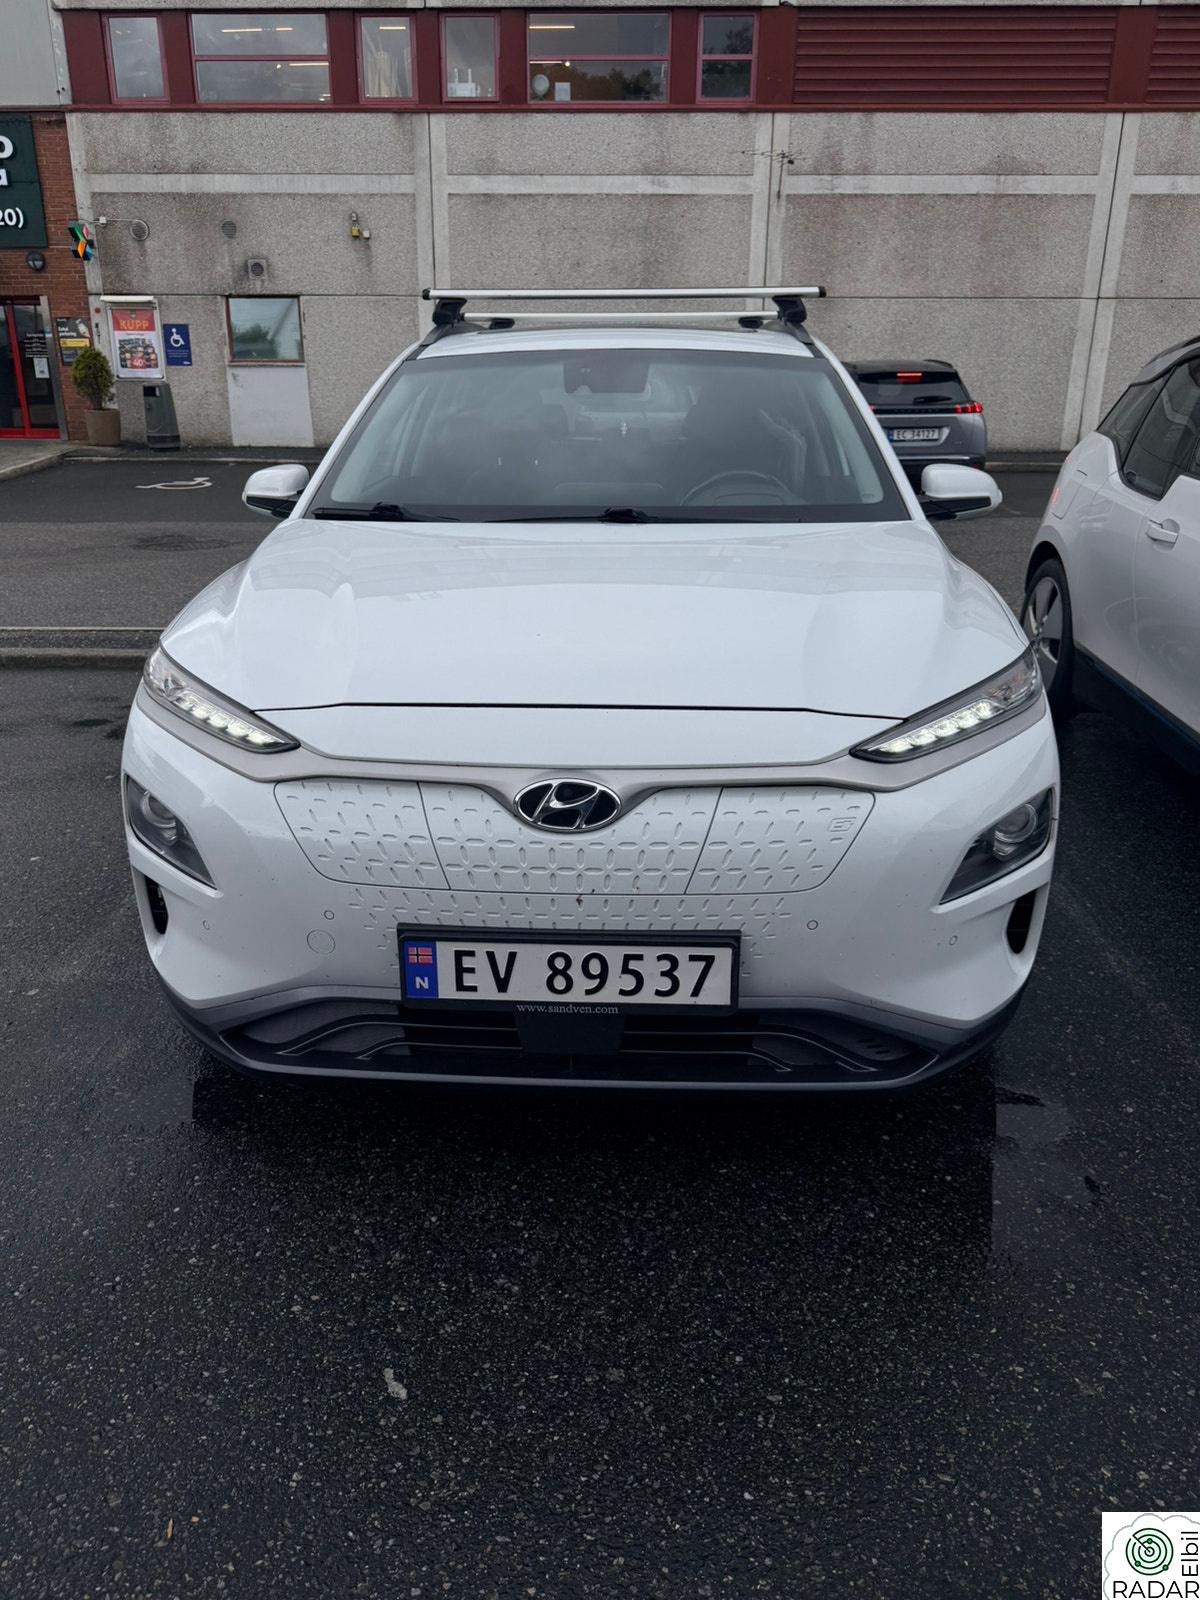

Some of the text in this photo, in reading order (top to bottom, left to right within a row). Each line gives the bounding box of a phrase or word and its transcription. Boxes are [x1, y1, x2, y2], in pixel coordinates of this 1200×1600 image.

[119, 319, 149, 330] KUPP
[896, 429, 936, 440] EC 34127
[415, 949, 716, 997] N EV 89537
[516, 1002, 619, 1015] www.sandven.com
